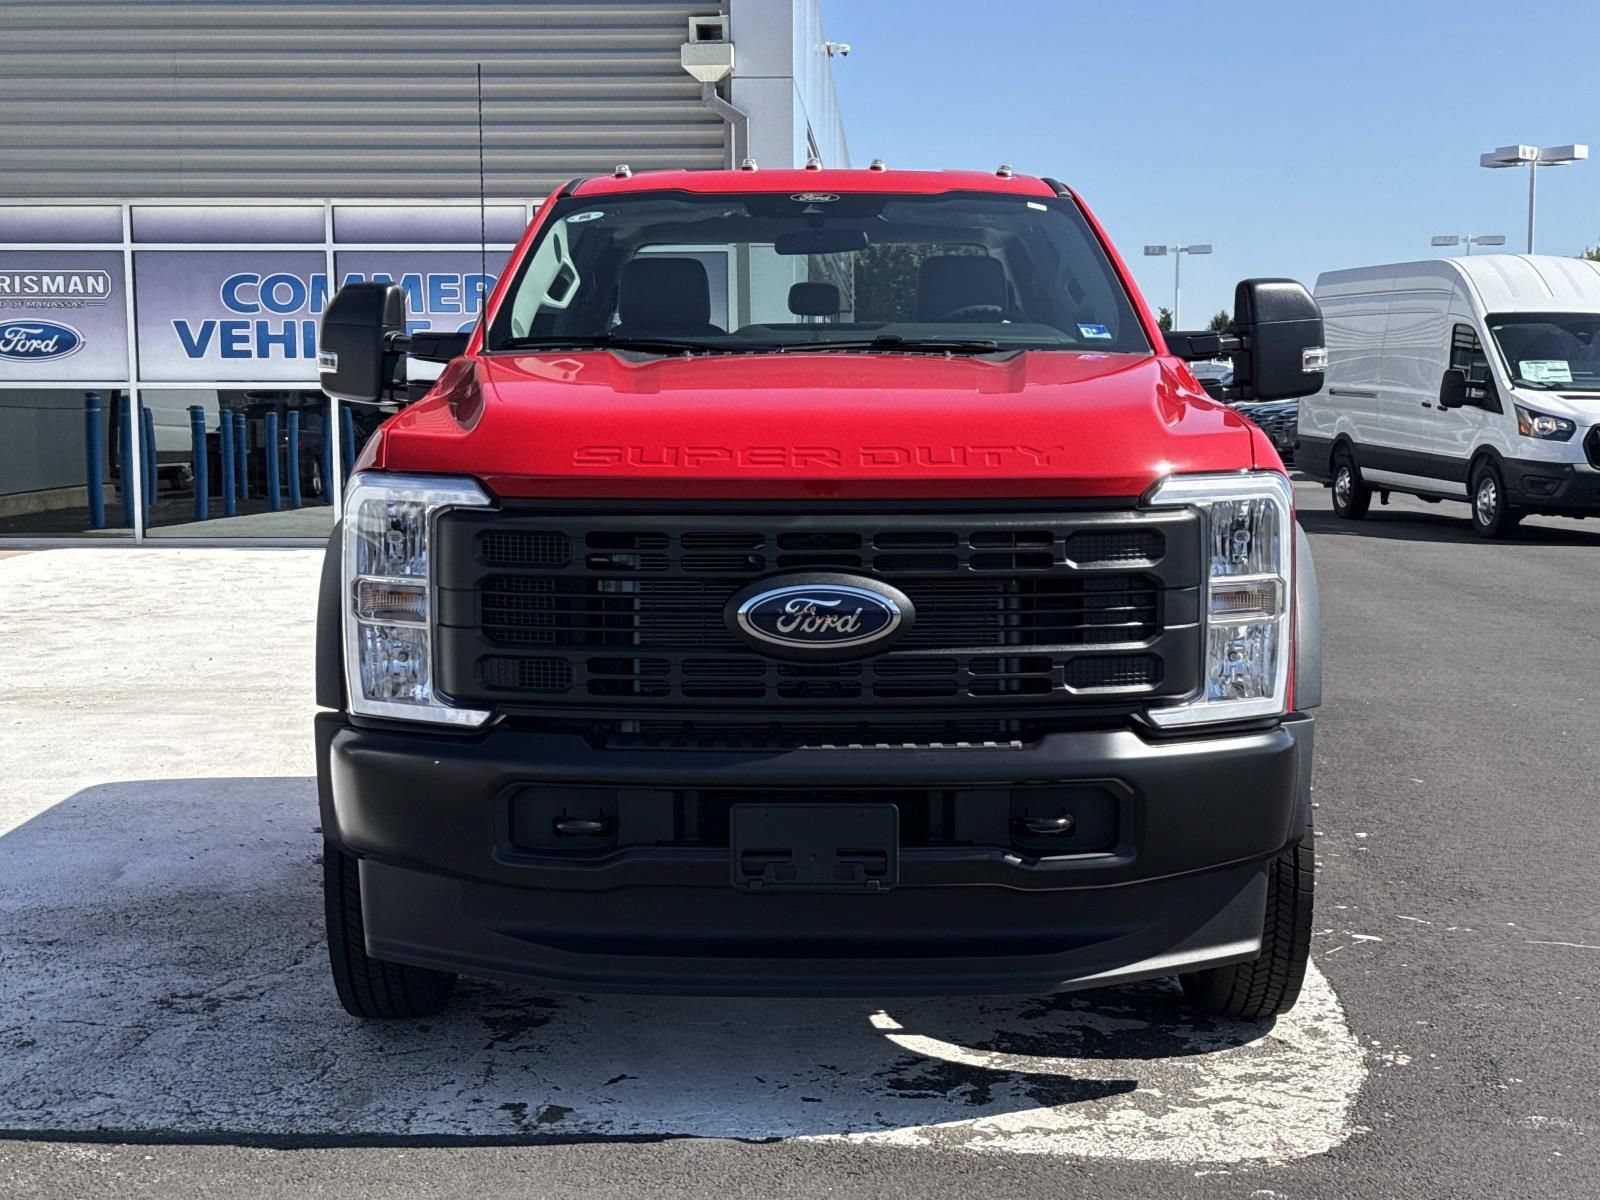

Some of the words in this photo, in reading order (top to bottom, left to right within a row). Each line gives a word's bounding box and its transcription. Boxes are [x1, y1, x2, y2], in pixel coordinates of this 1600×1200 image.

[0, 327, 59, 352] Ford
[572, 445, 841, 468] SUPER
[859, 445, 1065, 467] DUTY
[776, 598, 864, 633] Ford
